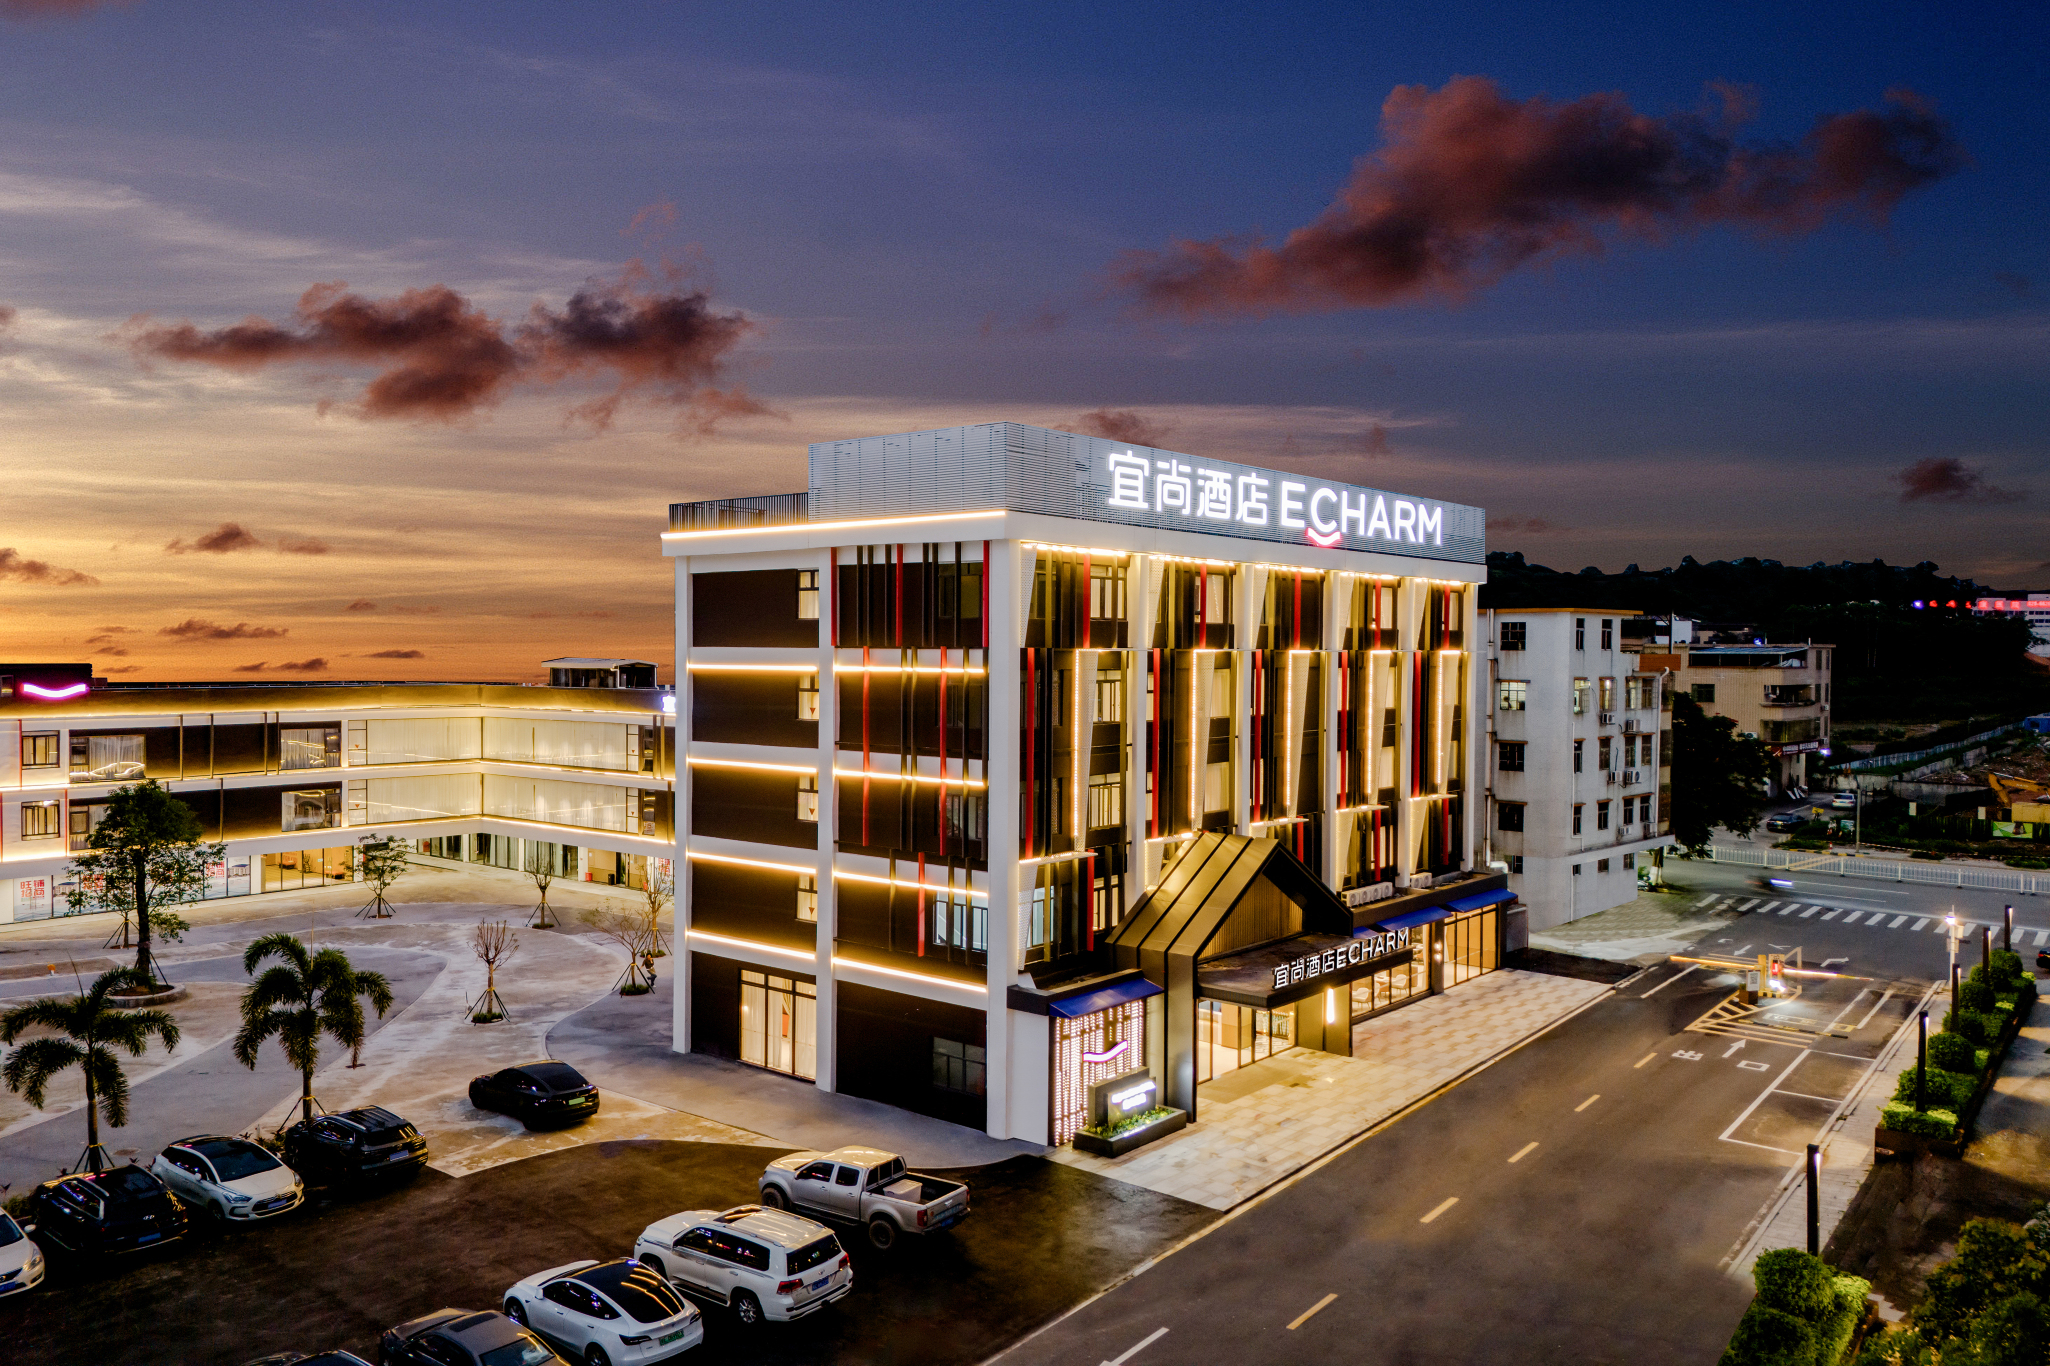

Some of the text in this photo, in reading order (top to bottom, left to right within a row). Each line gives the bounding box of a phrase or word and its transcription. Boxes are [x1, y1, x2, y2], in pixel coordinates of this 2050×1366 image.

[1107, 450, 1443, 546] 宜尚酒店 ECHARM
[1274, 926, 1409, 990] 宜尚酒店 ECHARM
